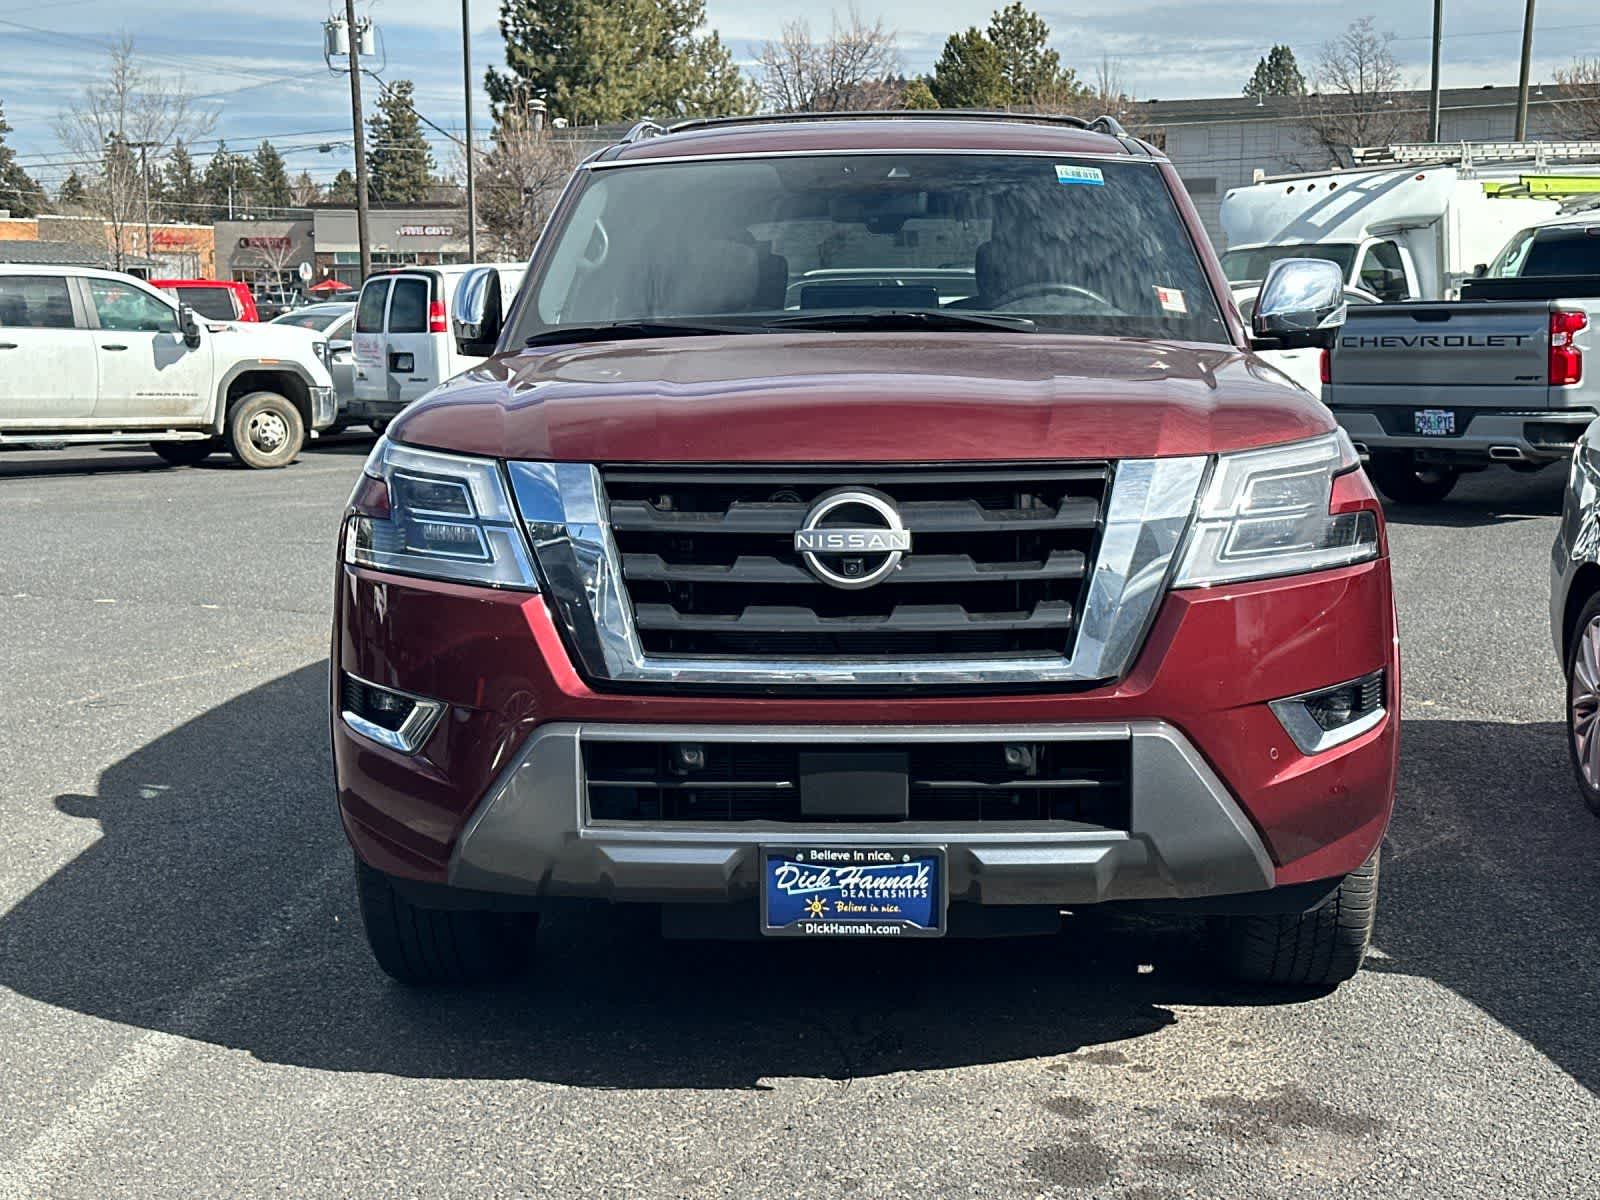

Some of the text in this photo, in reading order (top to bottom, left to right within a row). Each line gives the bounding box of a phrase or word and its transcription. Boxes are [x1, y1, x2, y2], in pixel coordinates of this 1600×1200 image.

[1342, 335, 1531, 348] CHEVROLET
[797, 534, 907, 548] NISSAN
[810, 850, 894, 861] Believe in nice.
[775, 865, 930, 890] Dick Hannah
[841, 889, 928, 898] DEALERSHIPS
[834, 900, 902, 913] Believe in nice.
[805, 923, 900, 935] DickHannah.com
